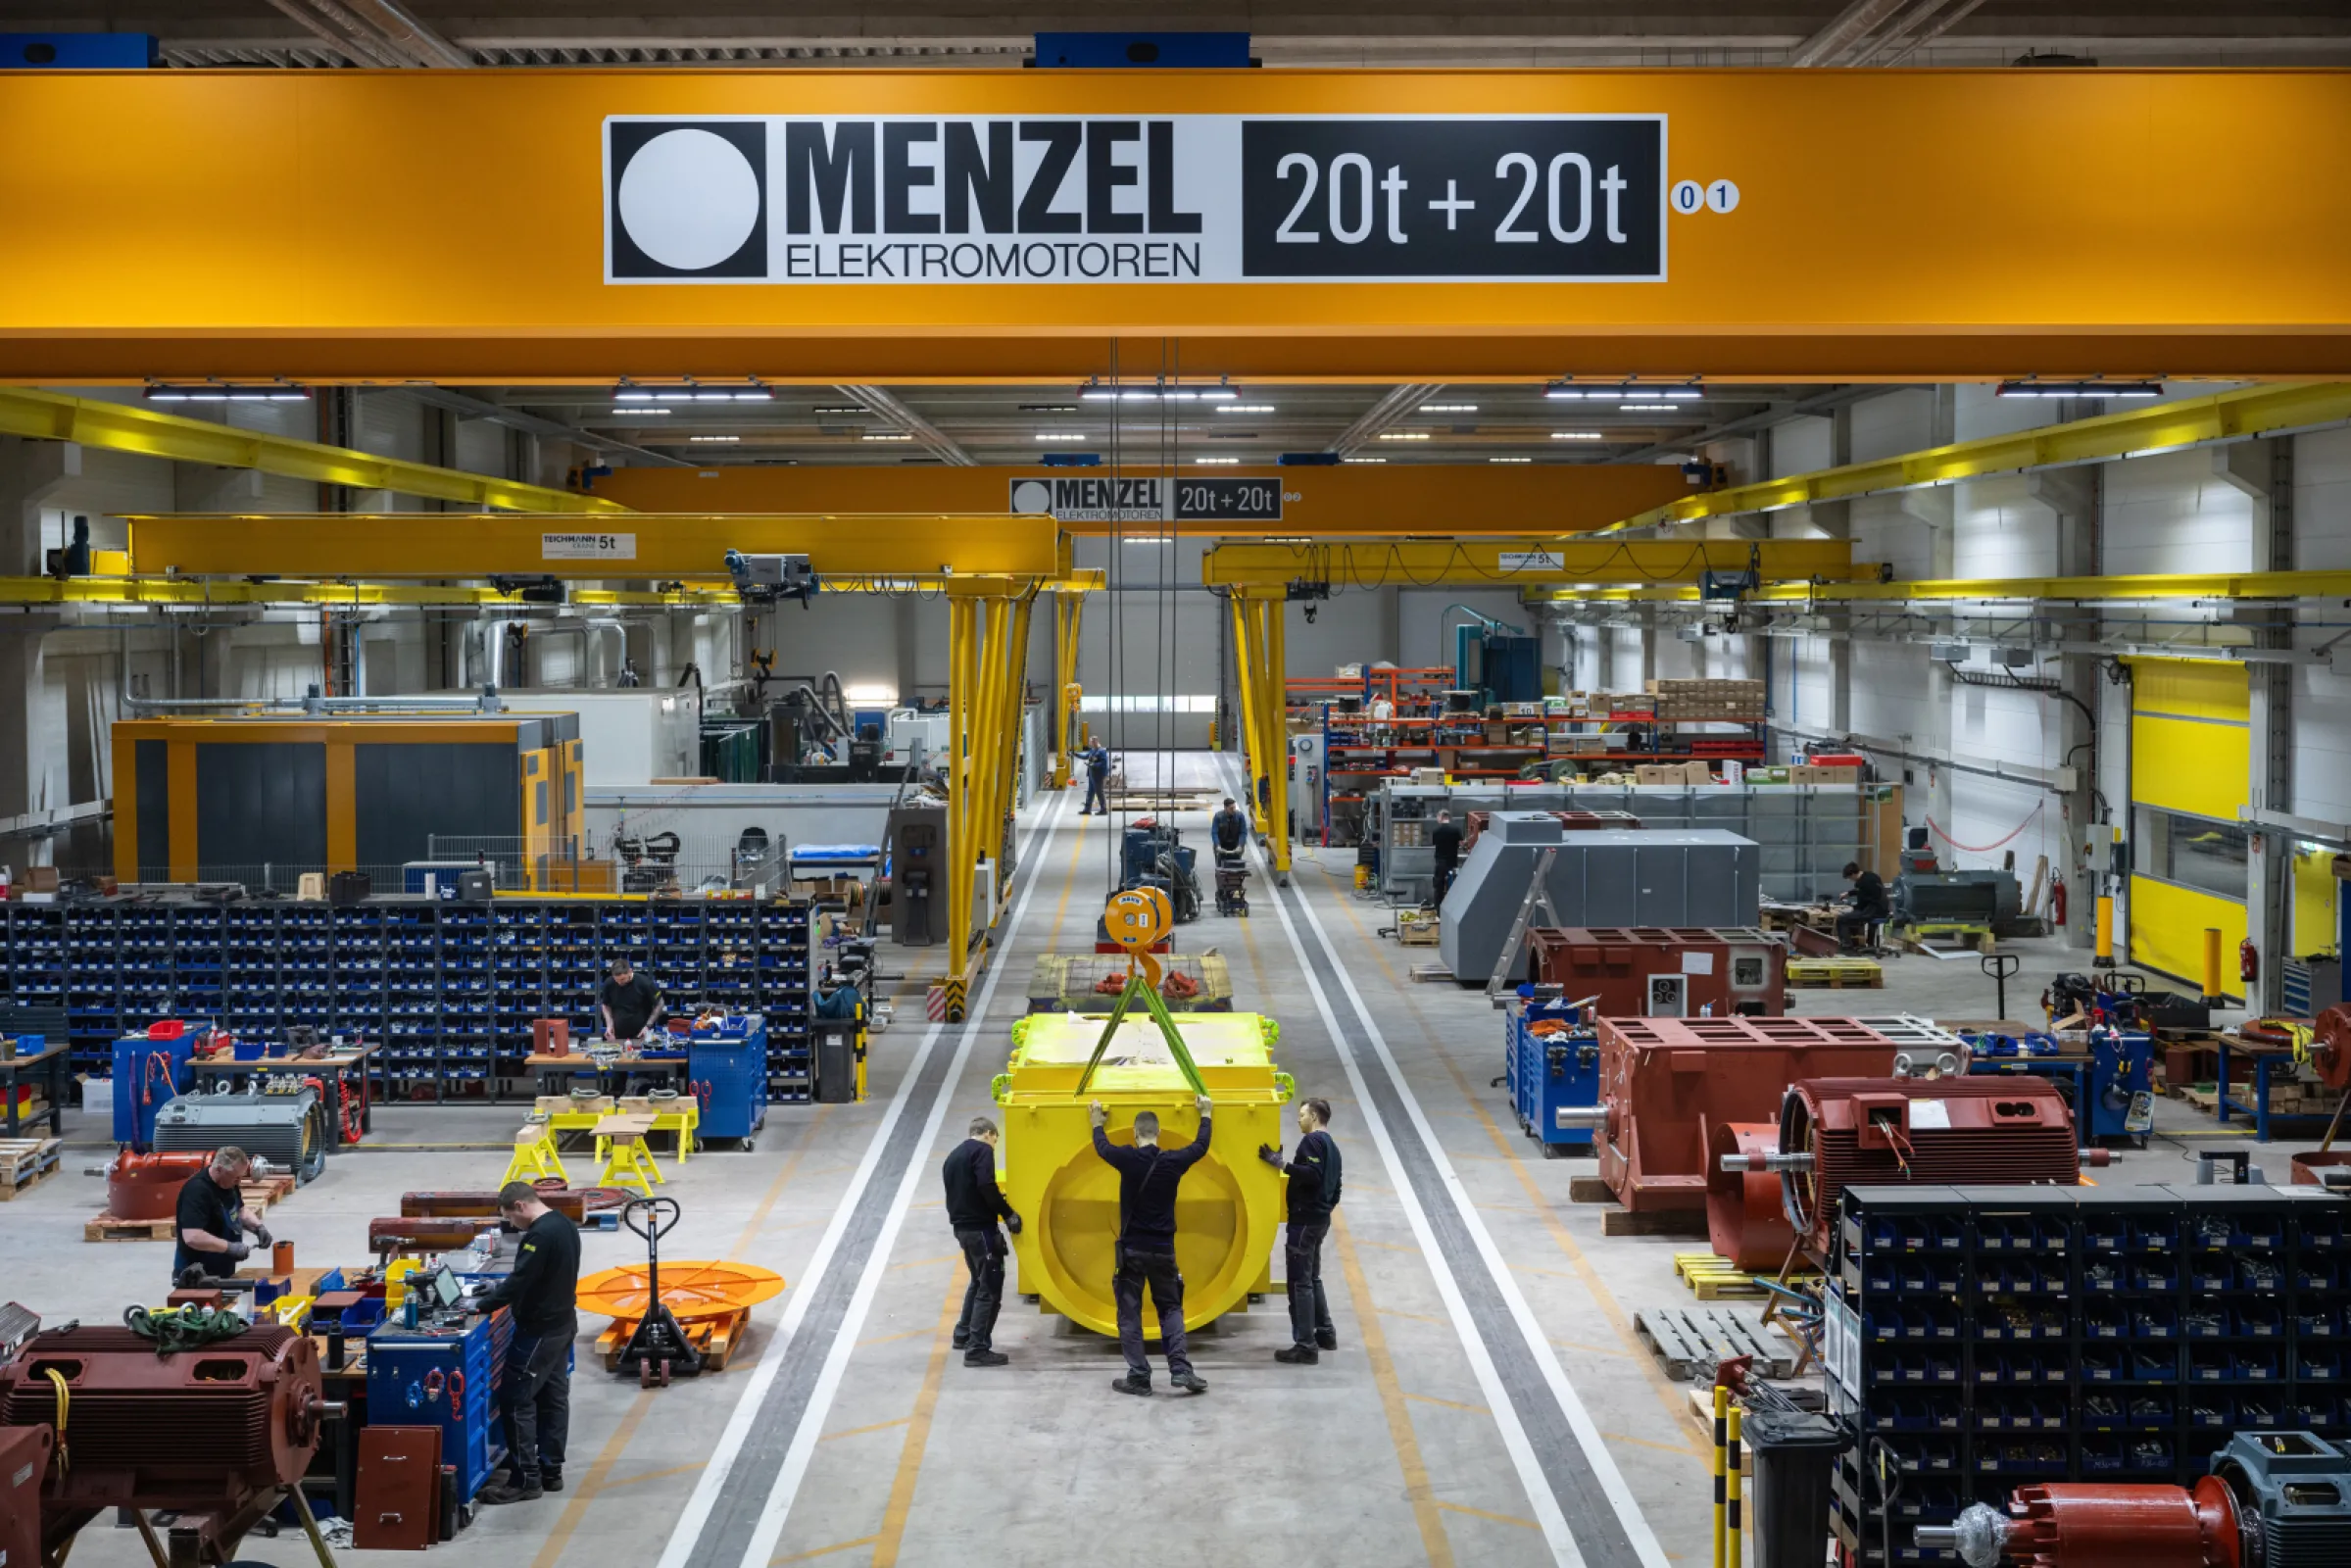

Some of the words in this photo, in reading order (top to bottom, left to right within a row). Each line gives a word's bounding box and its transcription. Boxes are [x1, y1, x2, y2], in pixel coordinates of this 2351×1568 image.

[785, 121, 1202, 234] MENZEL
[1275, 151, 1408, 245] 20t
[1428, 177, 1476, 231] +
[1494, 151, 1628, 244] 20t
[785, 241, 1202, 278] ELEKTROMOTOREN
[1055, 478, 1162, 509] MENZEL
[1181, 486, 1216, 512] 20t
[1220, 495, 1234, 511] +
[1238, 486, 1273, 512] 20t
